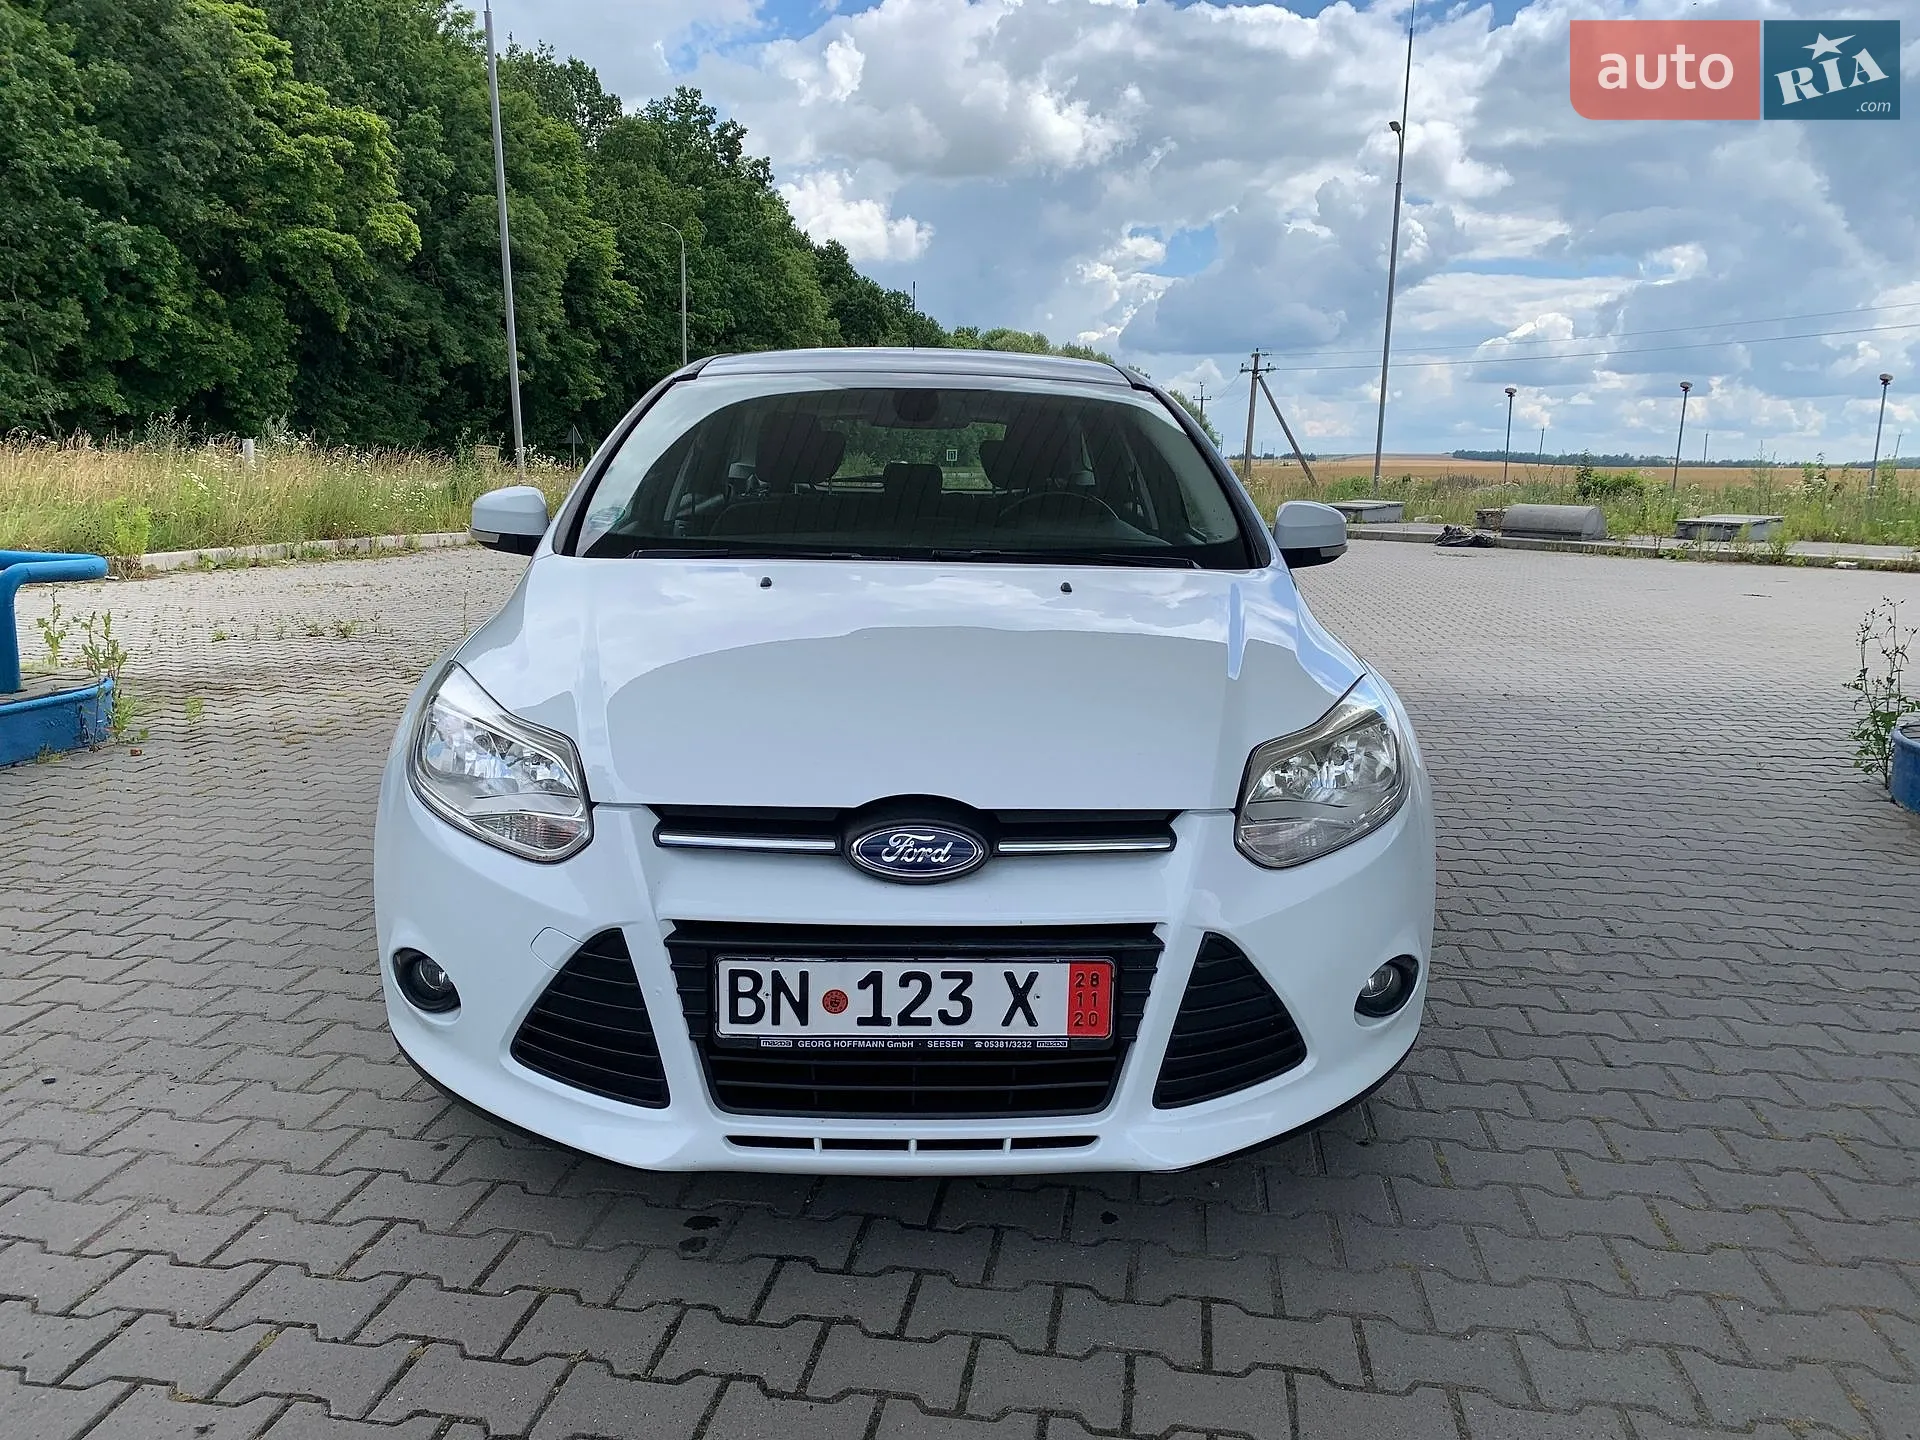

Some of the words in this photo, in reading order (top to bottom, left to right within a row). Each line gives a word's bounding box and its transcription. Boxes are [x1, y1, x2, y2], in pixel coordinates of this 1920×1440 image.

[881, 833, 953, 863] Ford
[1074, 971, 1100, 988] 28
[728, 969, 809, 1026] BN
[857, 970, 973, 1026] 123
[1001, 971, 1039, 1027] X
[1075, 990, 1098, 1008] 11
[1073, 1010, 1099, 1027] 20
[798, 1040, 831, 1048] GEORG
[833, 1040, 885, 1048] HOFFMANN
[887, 1040, 914, 1048] GmbH
[927, 1040, 964, 1048] SEESEN
